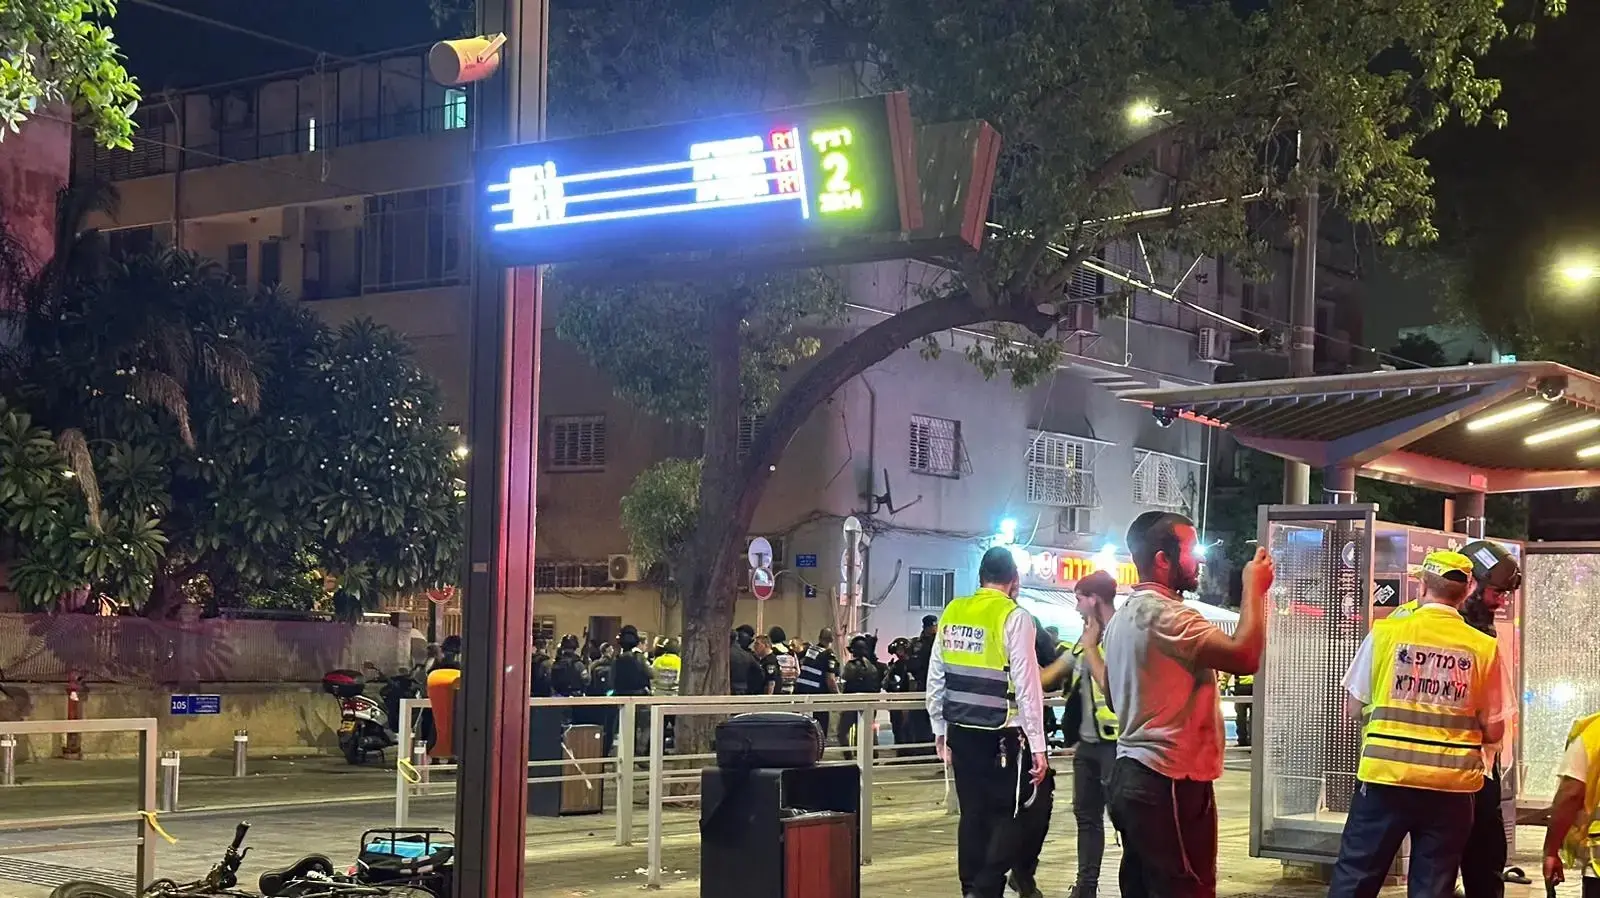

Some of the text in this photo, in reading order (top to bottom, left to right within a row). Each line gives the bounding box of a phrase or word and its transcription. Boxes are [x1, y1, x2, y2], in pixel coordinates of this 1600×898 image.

[772, 131, 794, 149] R1
[776, 153, 797, 171] R1
[822, 152, 851, 192] 2
[779, 175, 800, 193] R1
[172, 701, 187, 710] 105
